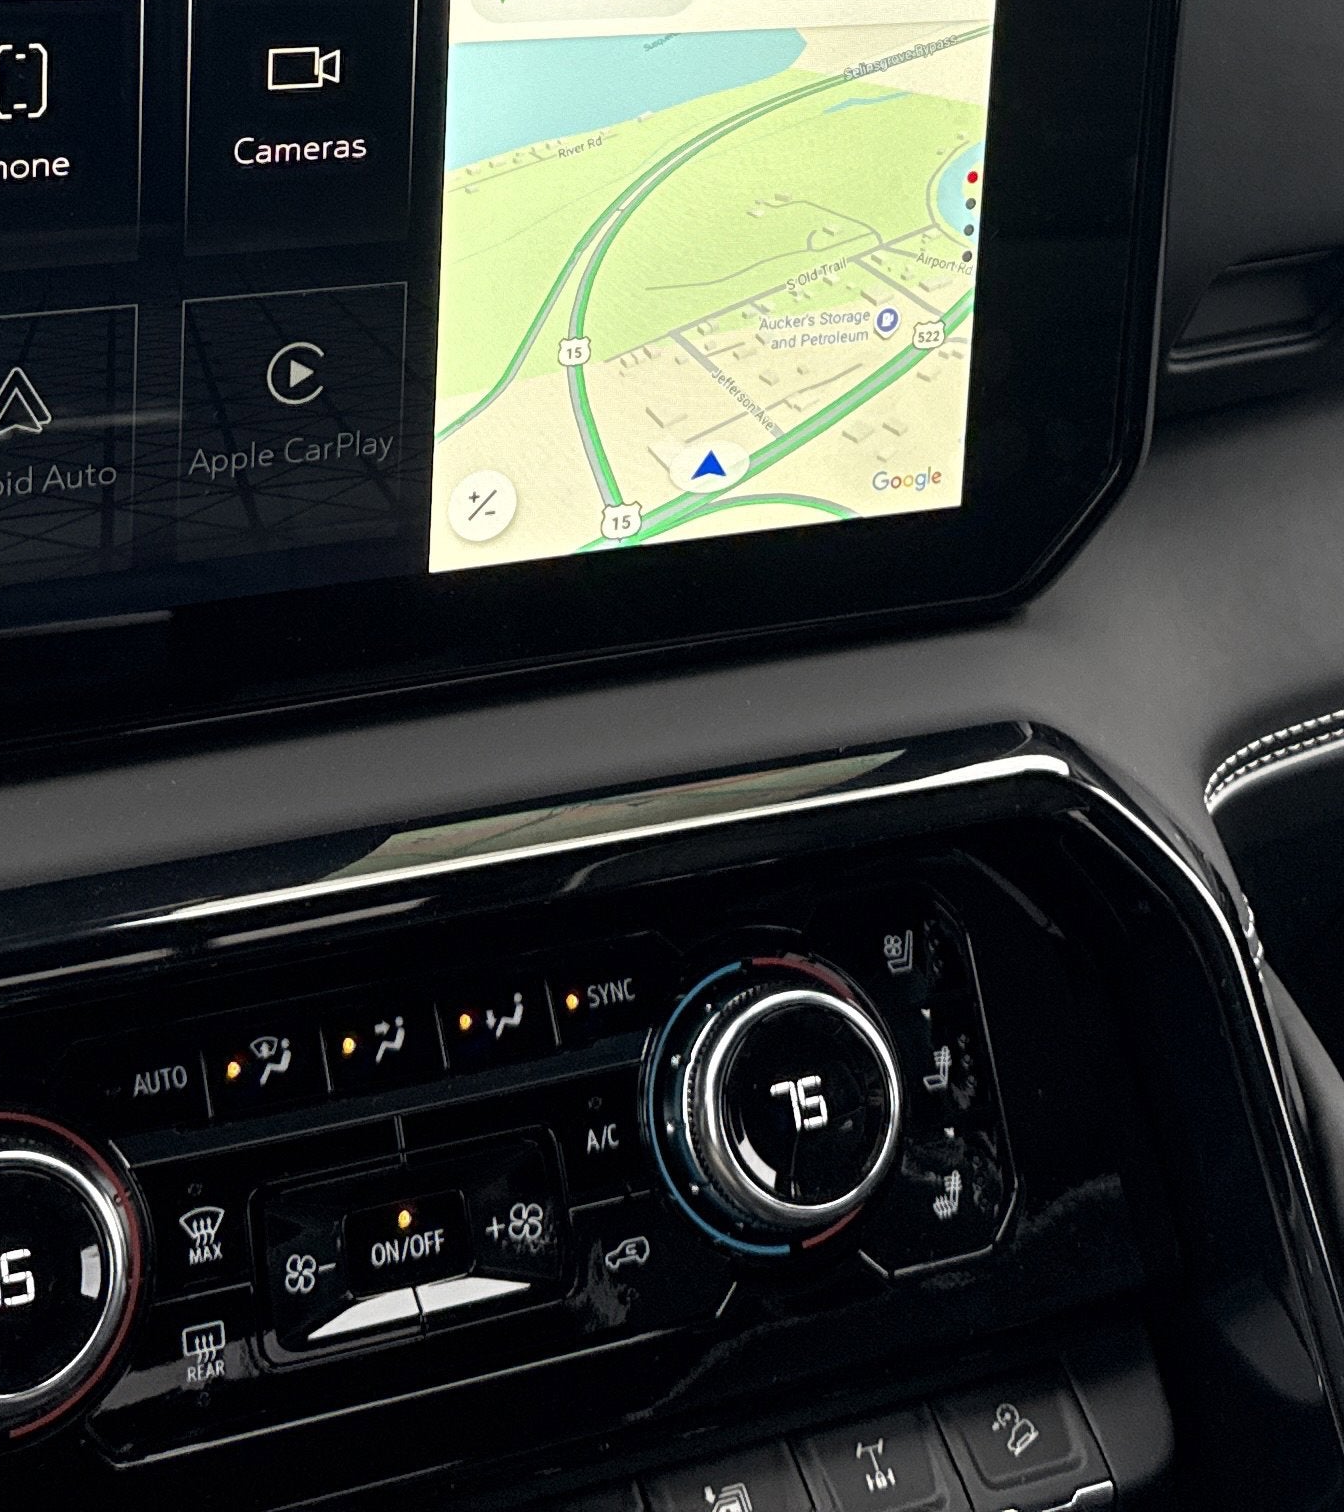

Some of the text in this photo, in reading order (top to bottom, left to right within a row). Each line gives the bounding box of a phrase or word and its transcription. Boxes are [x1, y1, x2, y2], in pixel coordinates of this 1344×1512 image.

[843, 34, 958, 81] Selinsgrove Bypass
[233, 135, 368, 167] Cameras
[558, 135, 603, 159] River Rd
[786, 256, 847, 291] S Old Trail
[915, 252, 974, 277] Airport Rd
[758, 309, 871, 331] Aucker's Storage
[771, 329, 869, 351] and Petroleum
[917, 330, 941, 344] 522
[565, 346, 583, 361] 15
[711, 369, 774, 430] Jefferson Ave
[188, 430, 395, 480] Apple CarPlay
[42, 462, 118, 492] Auto
[871, 467, 943, 493] Google
[611, 514, 632, 532] 15
[586, 978, 636, 1008] SYNC
[132, 1065, 188, 1098] AUTO
[769, 1075, 828, 1130] 75
[586, 1123, 620, 1155] A/C
[188, 1240, 224, 1266] MAX
[370, 1228, 445, 1267] ON/OFF
[186, 1358, 226, 1383] REAR
